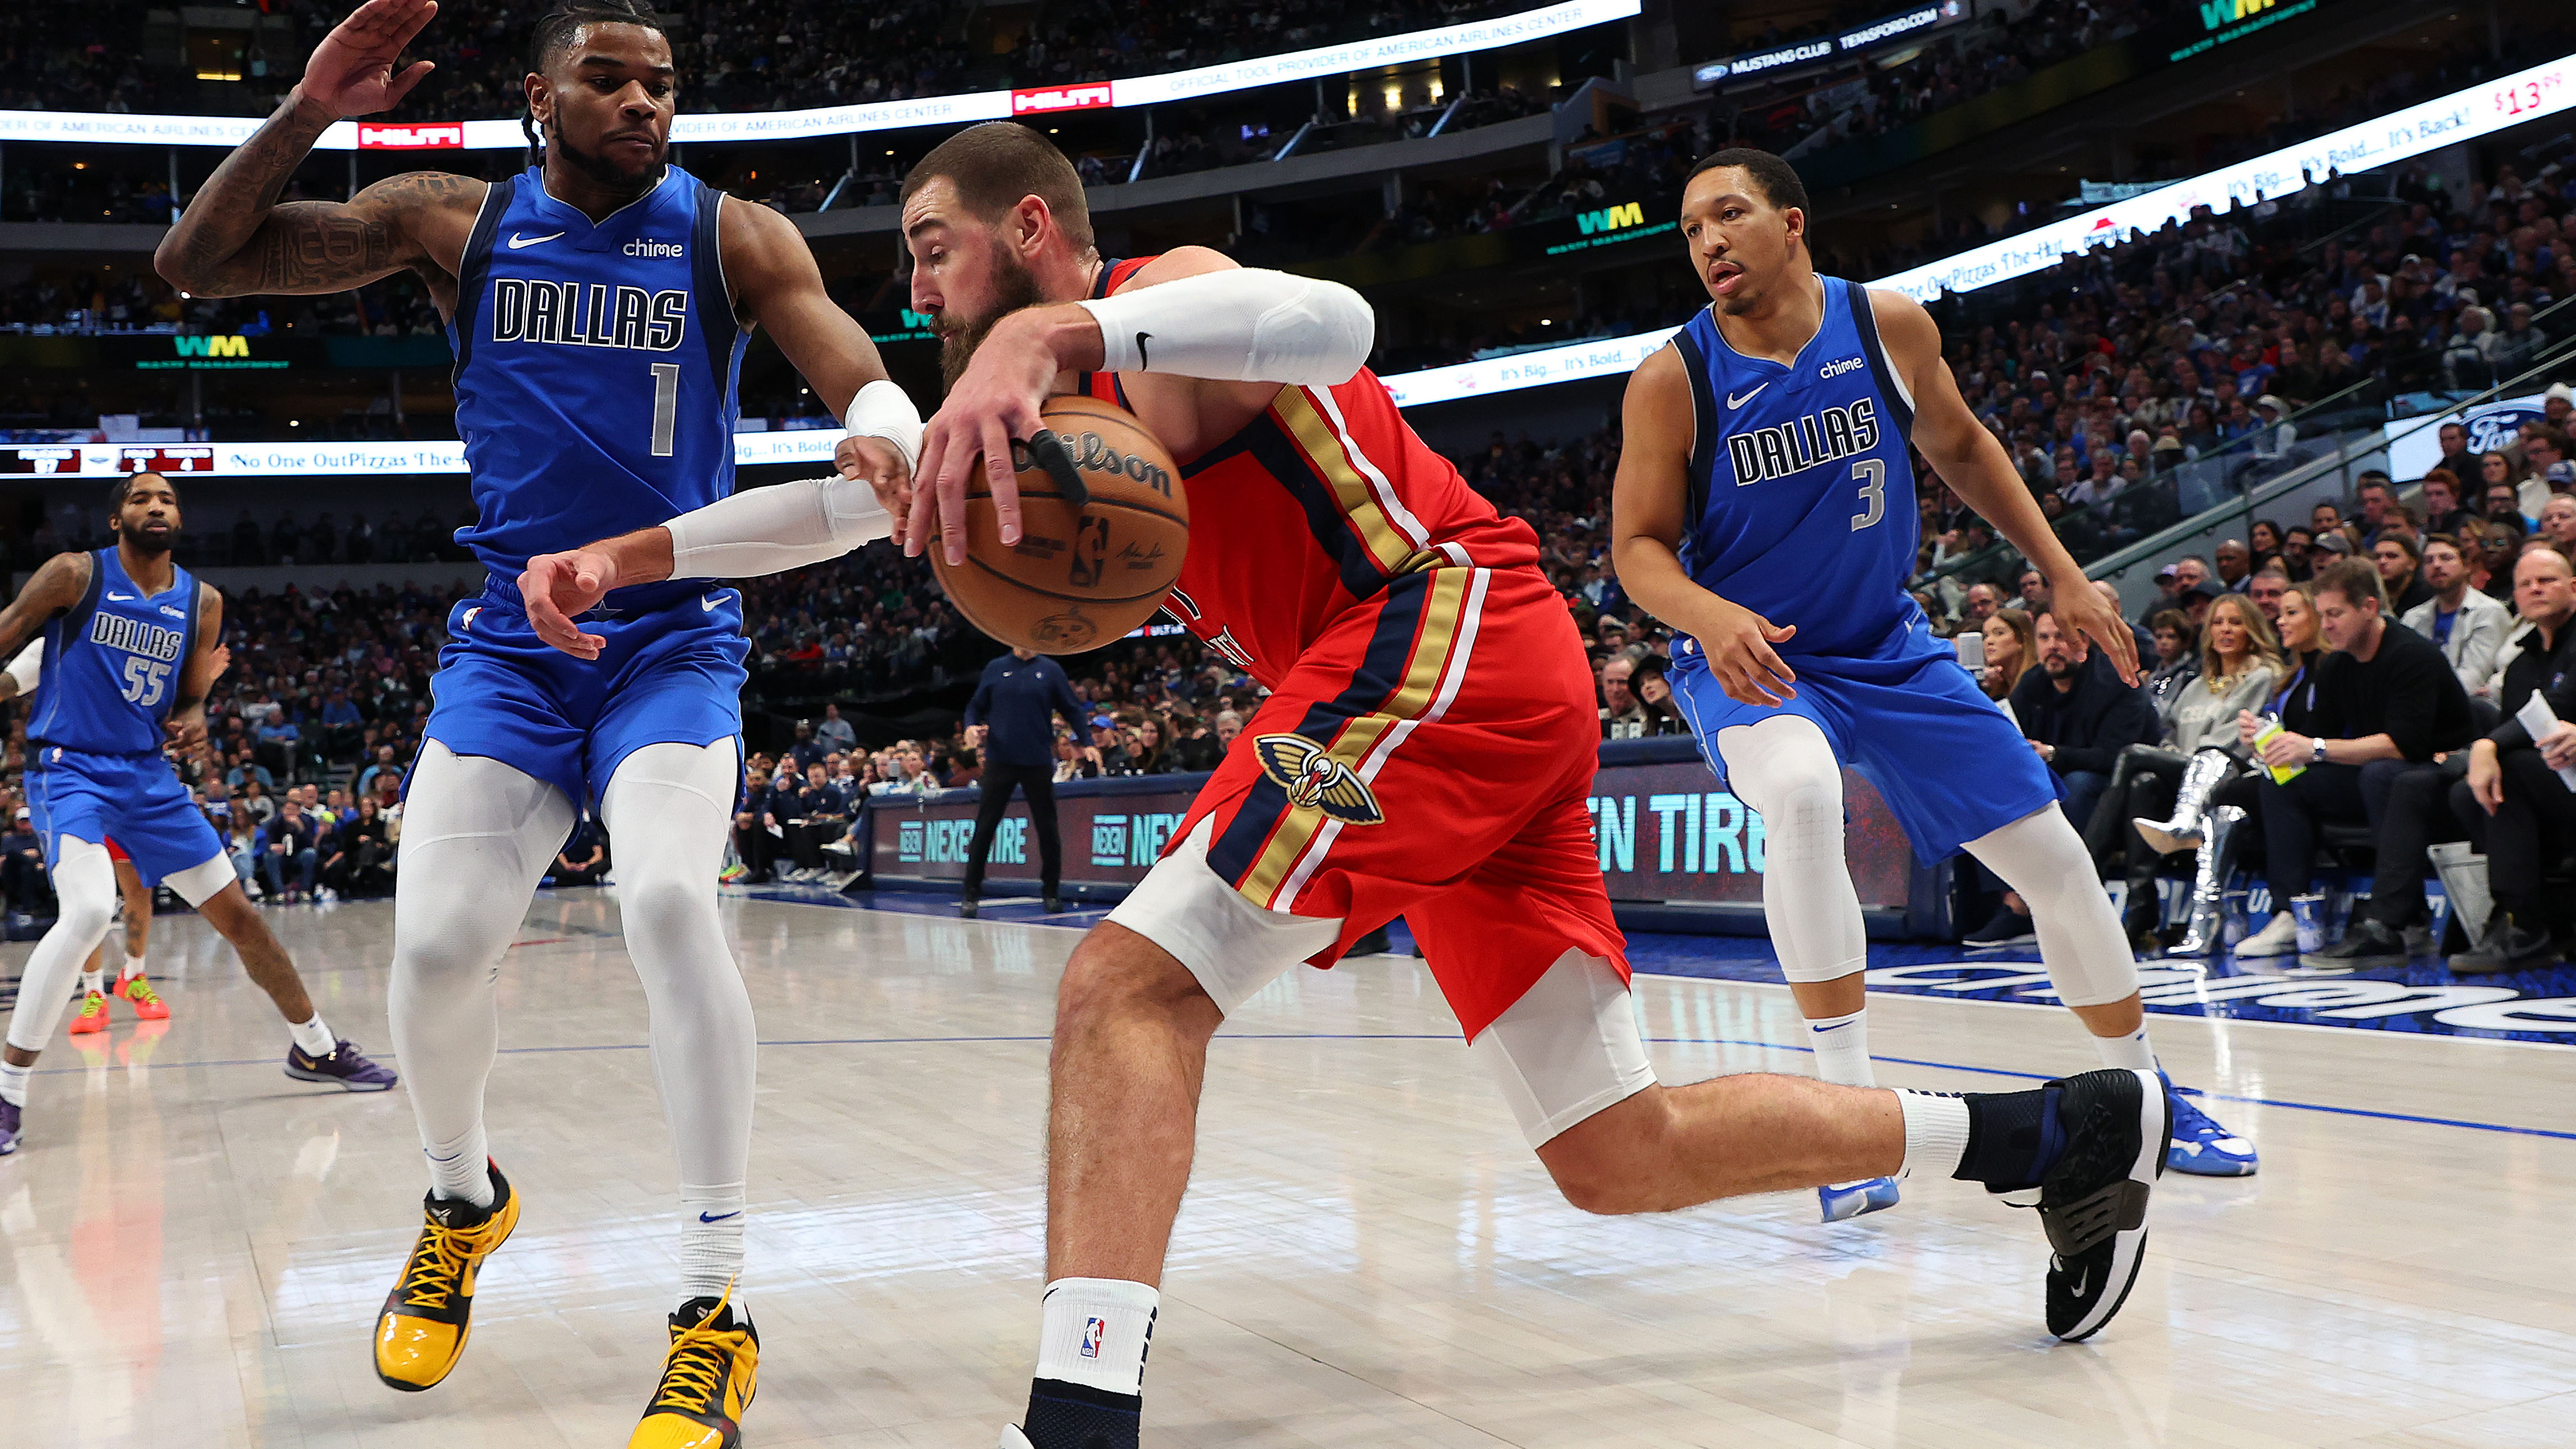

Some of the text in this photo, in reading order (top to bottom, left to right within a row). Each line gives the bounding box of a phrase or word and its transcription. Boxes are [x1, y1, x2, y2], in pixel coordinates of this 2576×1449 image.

[1170, 7, 1583, 91] OFFICIAL TOOL PROVIDER OF AMERICAN AIRLINES CENTER
[1015, 87, 1110, 111] HILTI
[672, 103, 952, 134] VIDER OF AMERICAN AIRLINES CENTER
[361, 127, 460, 145] HILTI
[1576, 201, 1644, 235] WM
[623, 238, 683, 257] chime
[494, 279, 688, 352] DALLAS
[174, 336, 249, 357] WM
[1820, 356, 1864, 379] chime
[650, 363, 679, 457] 1
[773, 442, 793, 454] It's
[1728, 397, 1880, 487] DALLAS
[230, 454, 260, 468] No
[269, 453, 306, 468] One
[313, 453, 408, 469] OutPizzas
[1851, 458, 1886, 532] 3
[90, 611, 184, 662] DALLAS
[121, 656, 172, 707] 55
[926, 819, 976, 863] NEXE
